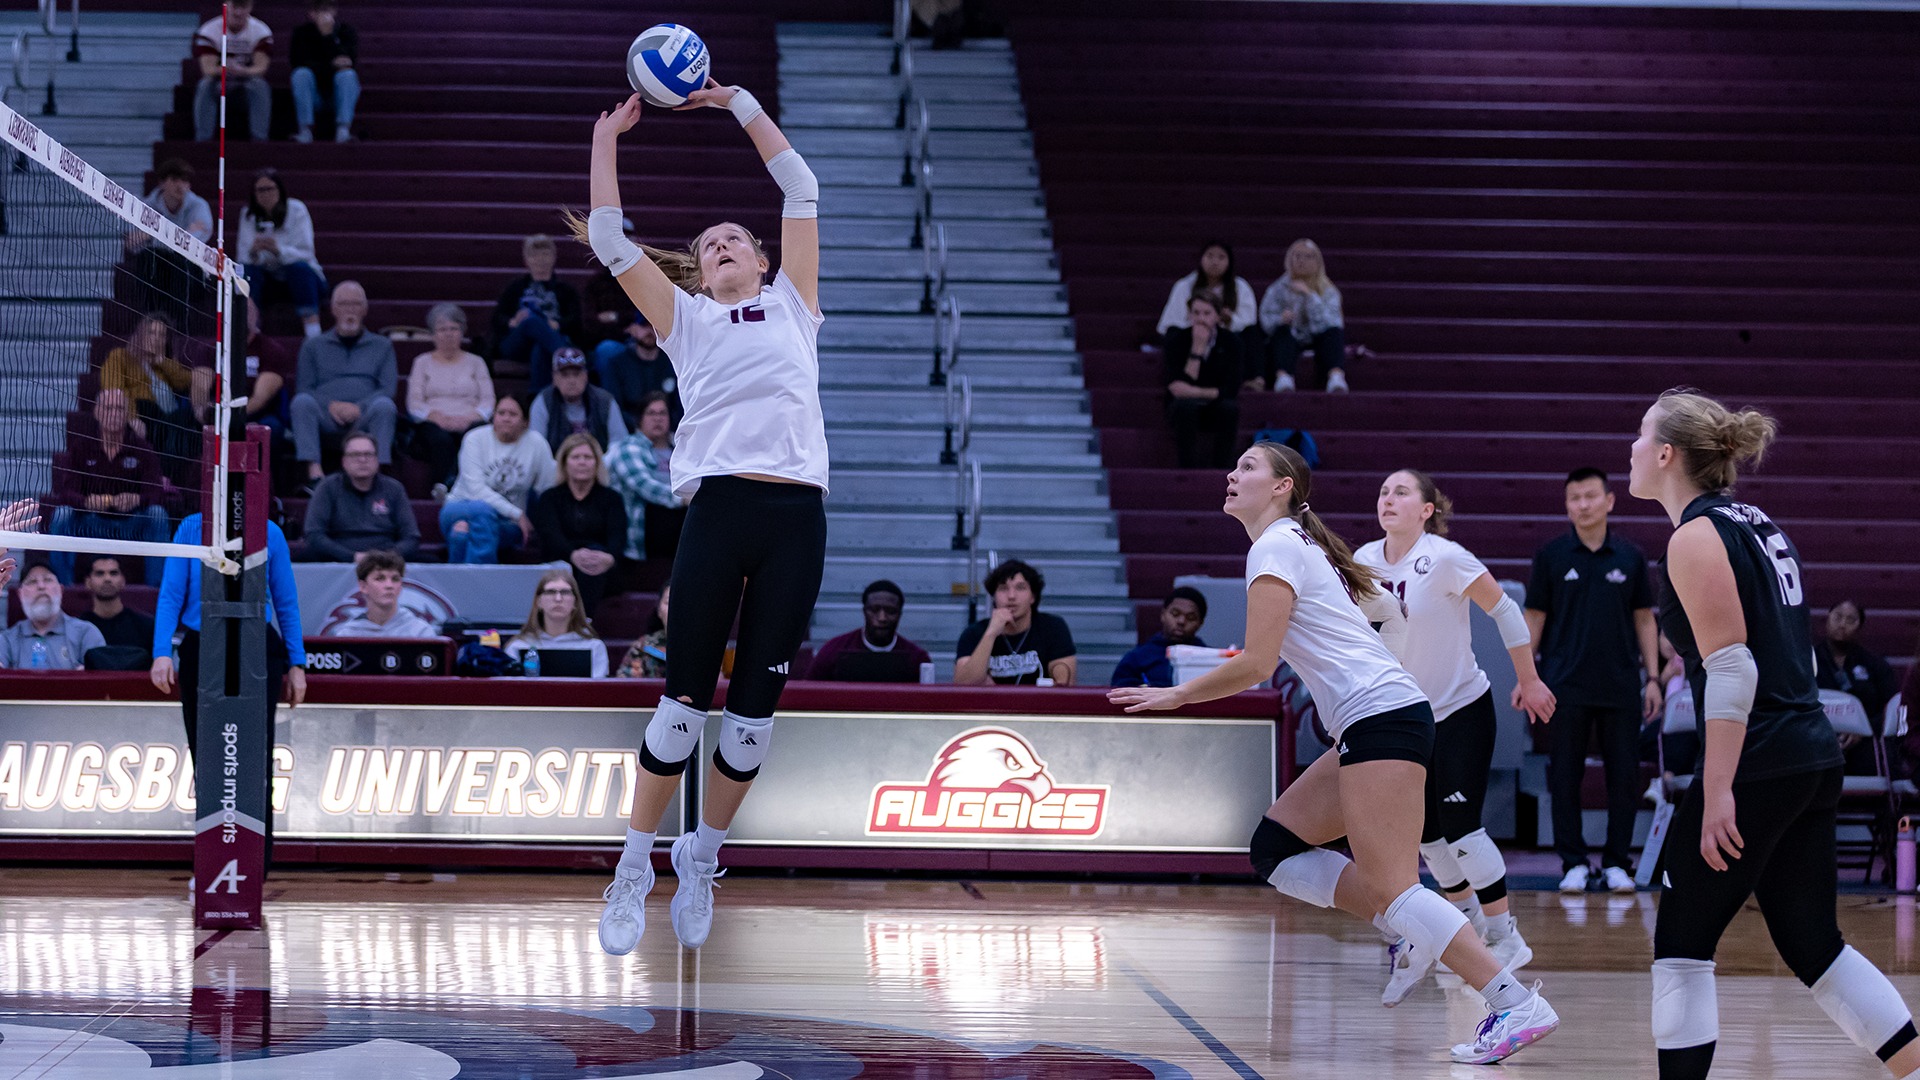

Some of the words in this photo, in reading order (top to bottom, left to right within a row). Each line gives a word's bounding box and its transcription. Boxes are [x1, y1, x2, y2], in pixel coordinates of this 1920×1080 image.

[690, 50, 708, 74] olten
[232, 491, 243, 531] sports
[305, 652, 342, 669] POSS
[385, 655, 397, 668] B
[421, 655, 432, 668] B
[221, 723, 239, 777] sports
[0, 742, 295, 813] AUGSBG
[320, 747, 638, 817] UNIVERSITY
[219, 779, 238, 844] imports
[875, 790, 1100, 830] AUGGIES
